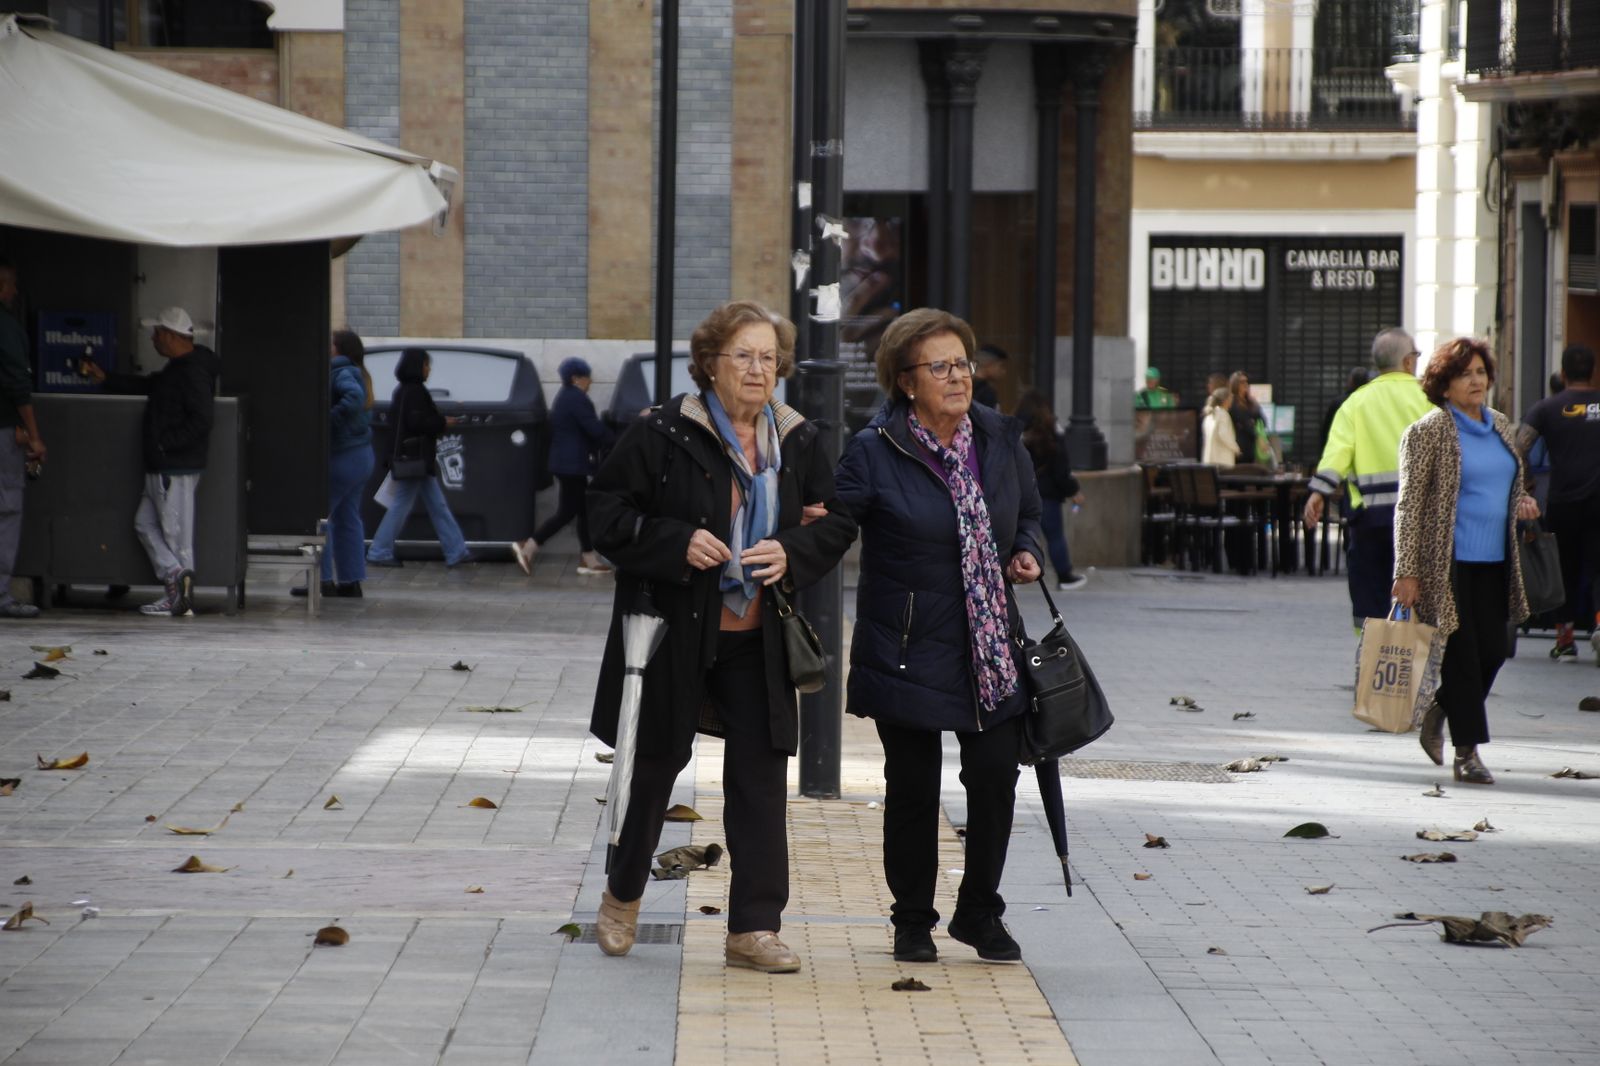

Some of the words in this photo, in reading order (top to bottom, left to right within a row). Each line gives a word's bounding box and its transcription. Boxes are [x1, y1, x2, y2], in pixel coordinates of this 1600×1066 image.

[1286, 250, 1364, 268] CANAGLIA
[1368, 250, 1399, 268] BAR
[1311, 270, 1323, 288] &
[1327, 270, 1375, 288] RESTO
[45, 330, 103, 346] Mahou
[1372, 659, 1397, 690] 50
